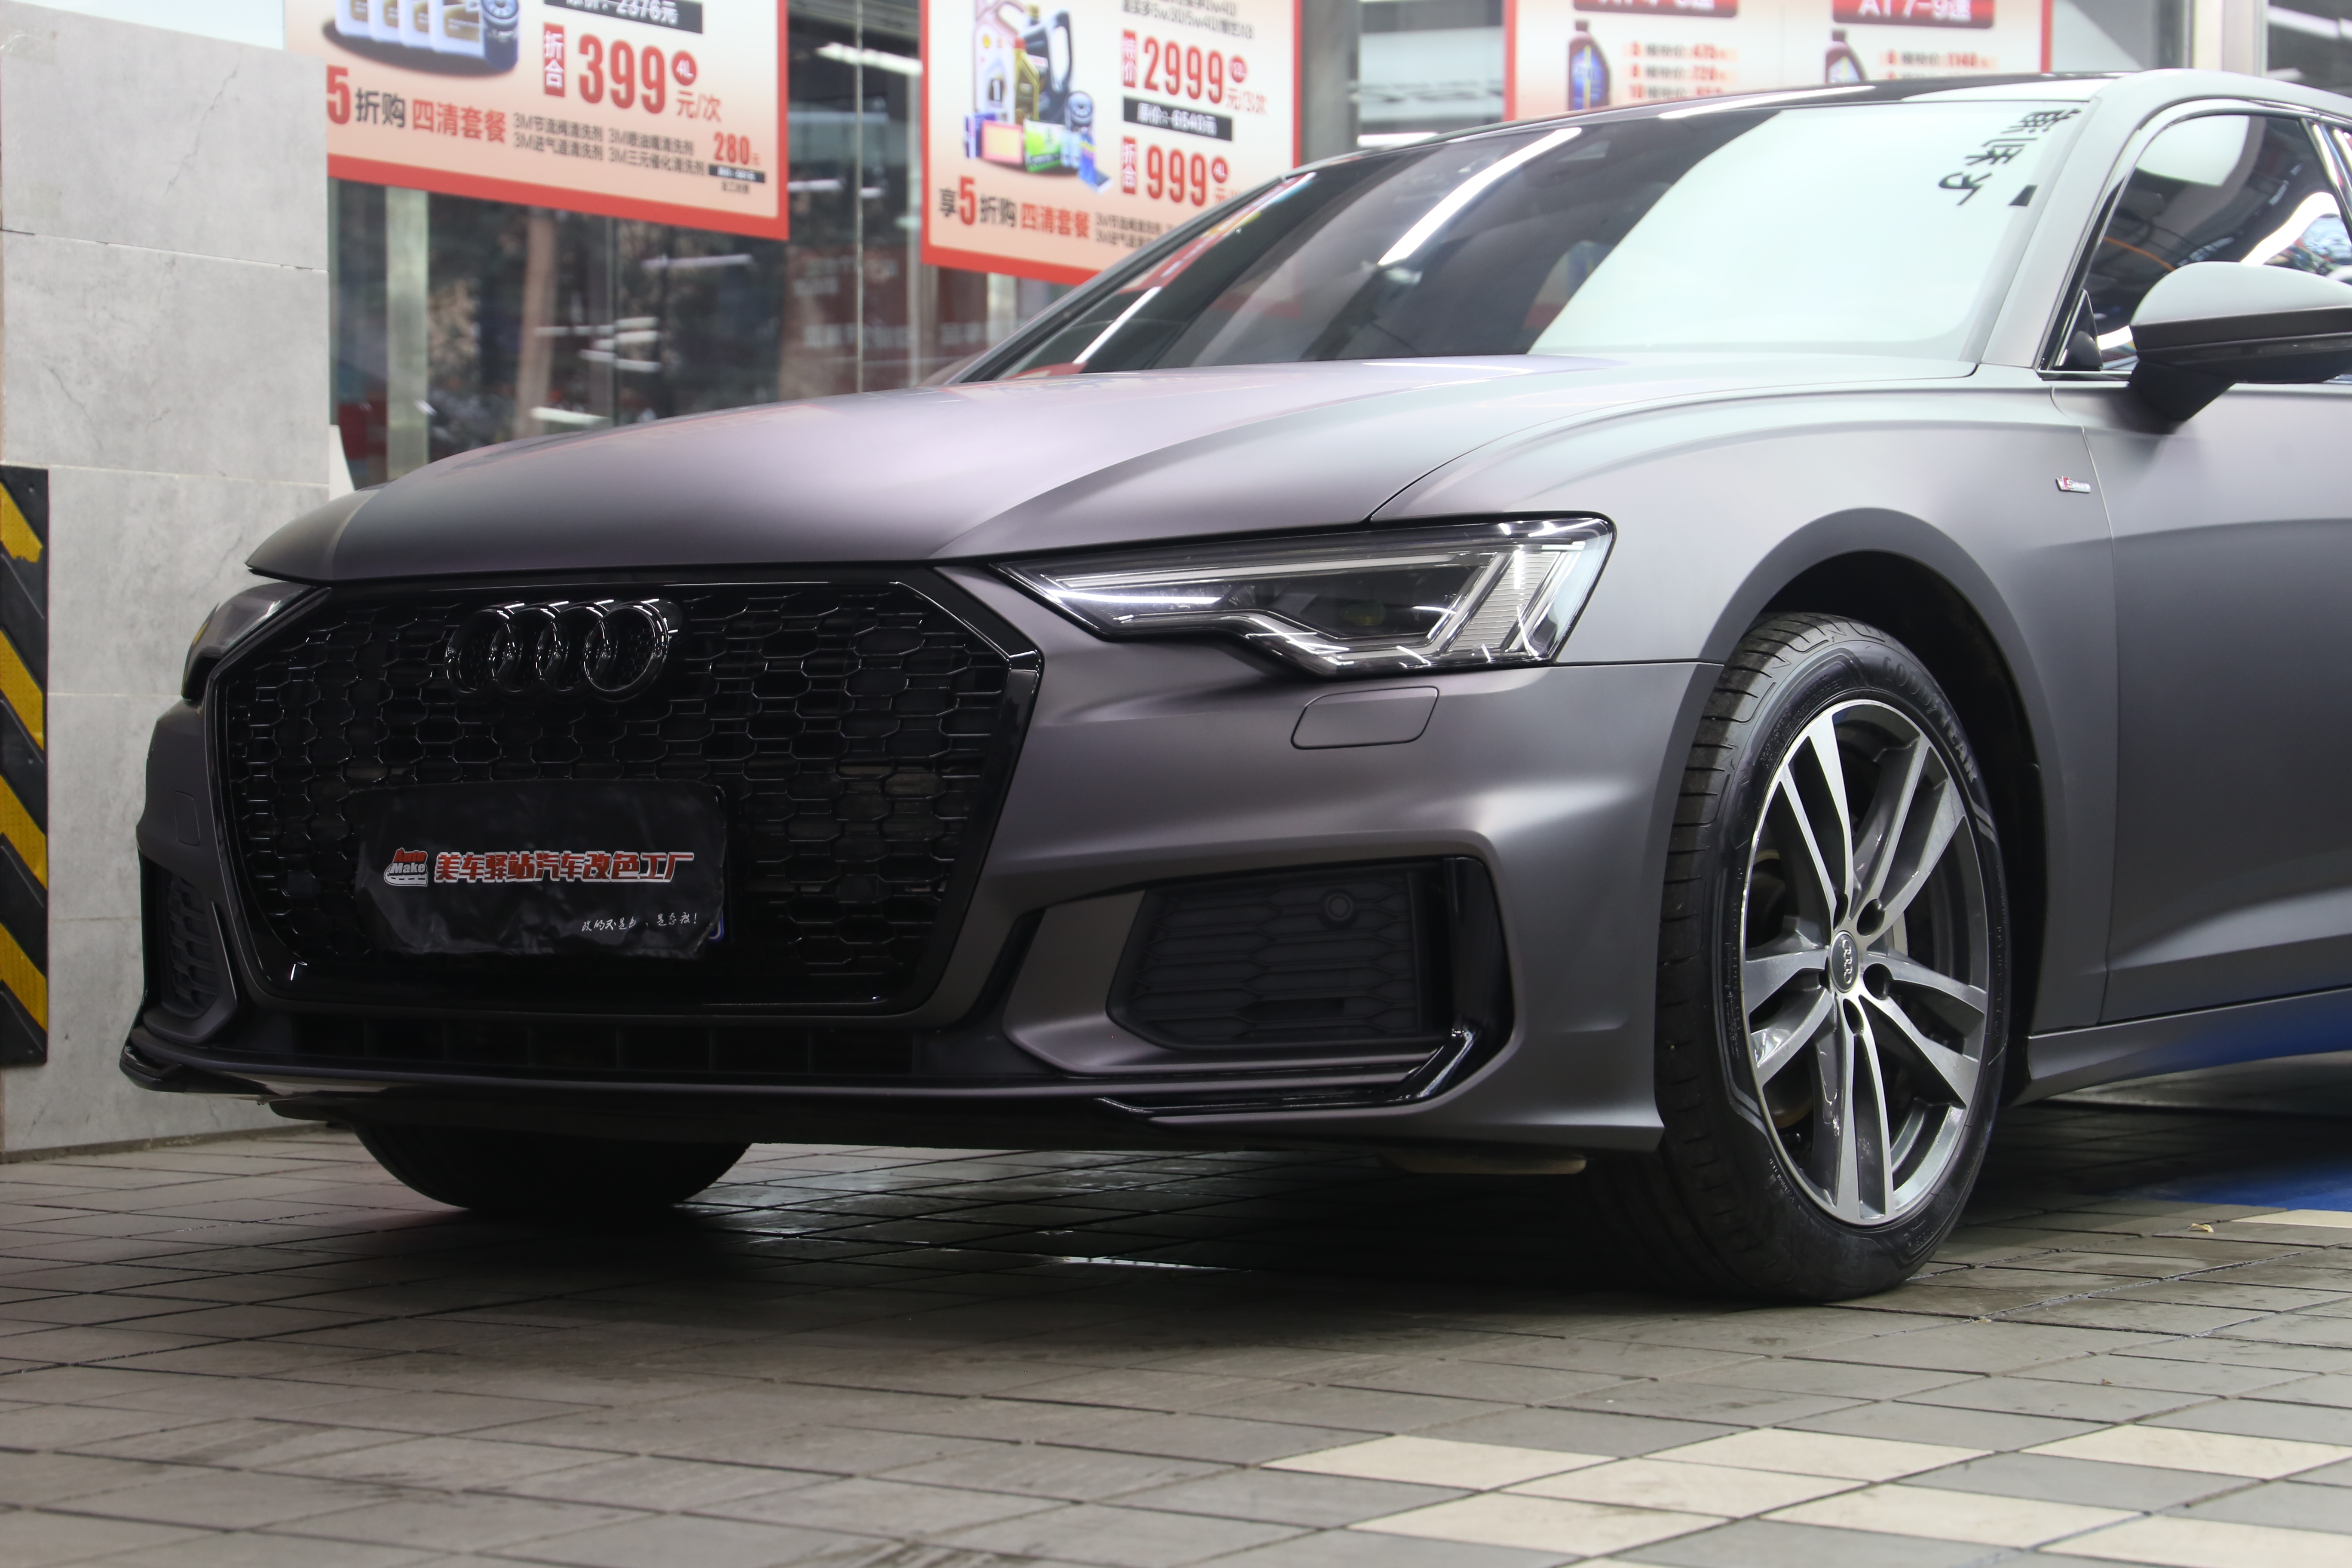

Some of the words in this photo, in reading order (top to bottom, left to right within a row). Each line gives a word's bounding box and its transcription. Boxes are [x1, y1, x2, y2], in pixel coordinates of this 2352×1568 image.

[544, 30, 564, 88] 折合
[579, 34, 665, 114] 399
[676, 59, 695, 79] 4L
[1144, 36, 1223, 104] 2999
[412, 98, 506, 143] 四清套餐
[677, 89, 721, 122] 元/次
[1147, 144, 1206, 206] 999
[1883, 656, 1977, 783] GOODYEAR
[389, 863, 426, 874] Make
[393, 848, 427, 863] Auto
[435, 851, 694, 883] 美车驿站汽车改色工厂
